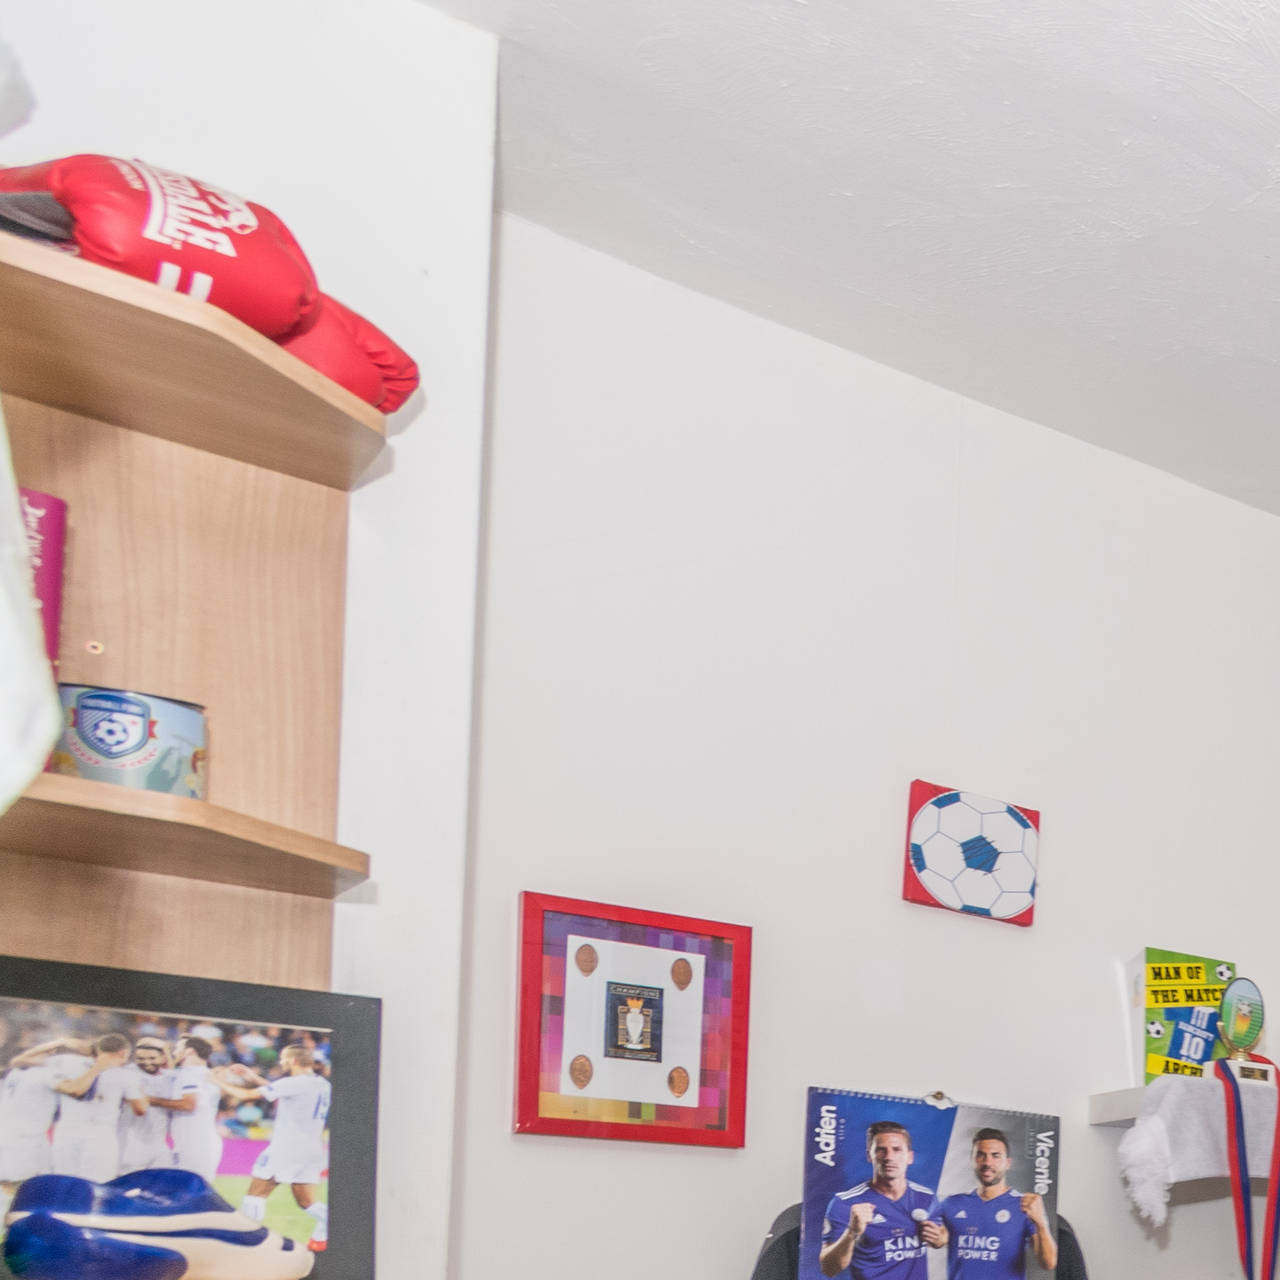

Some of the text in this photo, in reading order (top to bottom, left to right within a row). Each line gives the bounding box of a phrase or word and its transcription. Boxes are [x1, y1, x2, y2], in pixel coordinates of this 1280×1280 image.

[1151, 967, 1202, 980] MAN OF
[1151, 989, 1179, 1003] THE
[1179, 1032, 1205, 1060] 10
[814, 1105, 837, 1167] Adrien
[958, 1235, 1000, 1250] KING
[957, 1249, 999, 1262] POWER
